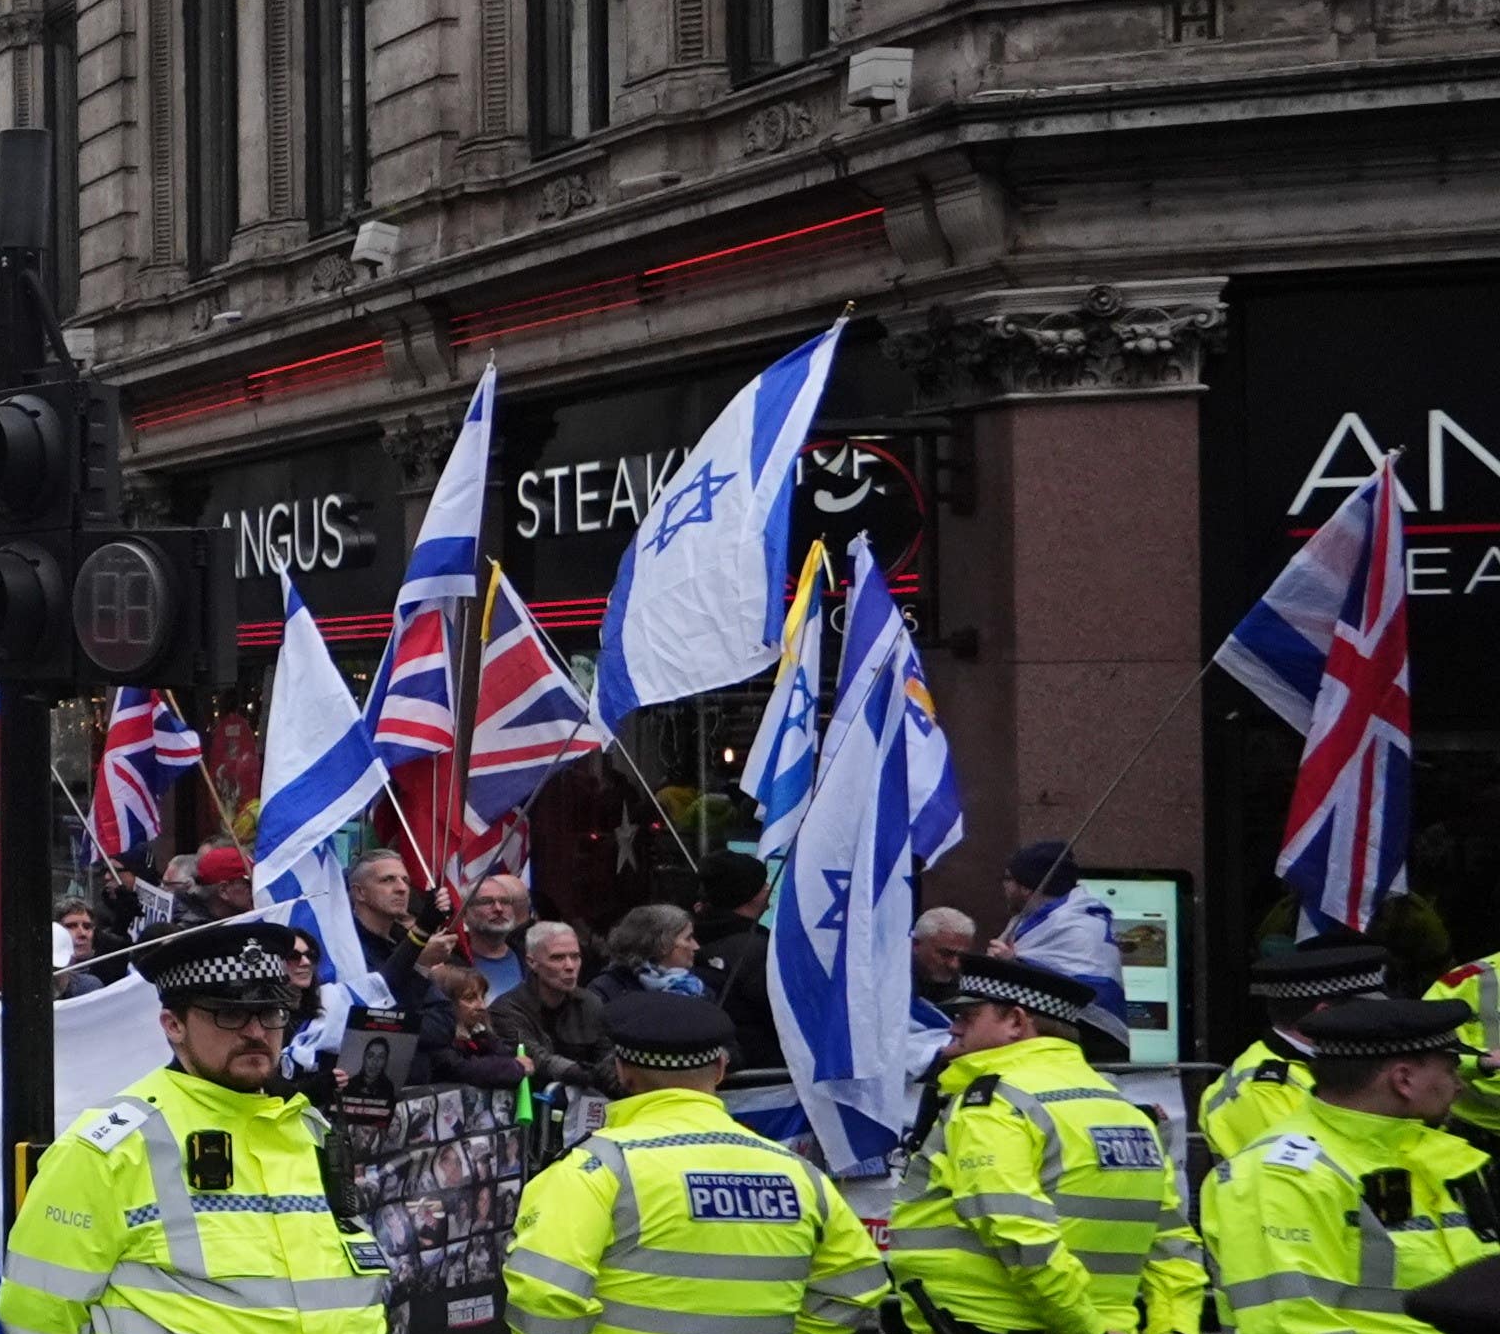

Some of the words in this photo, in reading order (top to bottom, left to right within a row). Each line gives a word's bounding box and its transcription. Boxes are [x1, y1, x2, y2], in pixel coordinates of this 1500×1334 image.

[957, 1154, 995, 1172] POLICE
[1098, 1140, 1160, 1166] POLICE
[690, 1187, 798, 1219] POLICE
[44, 1205, 93, 1230] POLICE
